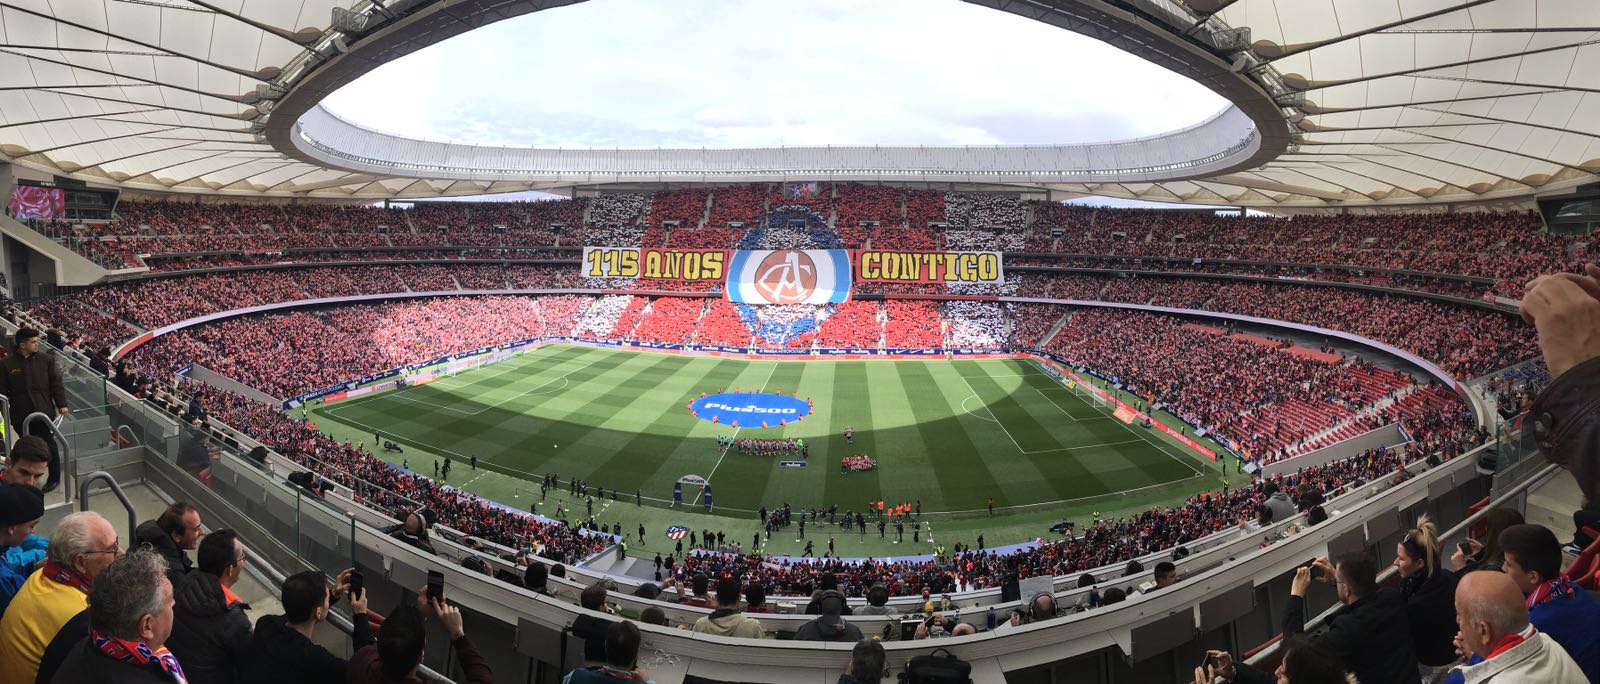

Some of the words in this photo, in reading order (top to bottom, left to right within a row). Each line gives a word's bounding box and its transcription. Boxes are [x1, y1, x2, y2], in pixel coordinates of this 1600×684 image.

[588, 249, 640, 277] 115
[644, 250, 723, 280] AÑOS
[860, 251, 998, 281] CONTIGO
[704, 403, 797, 413] Plus500
